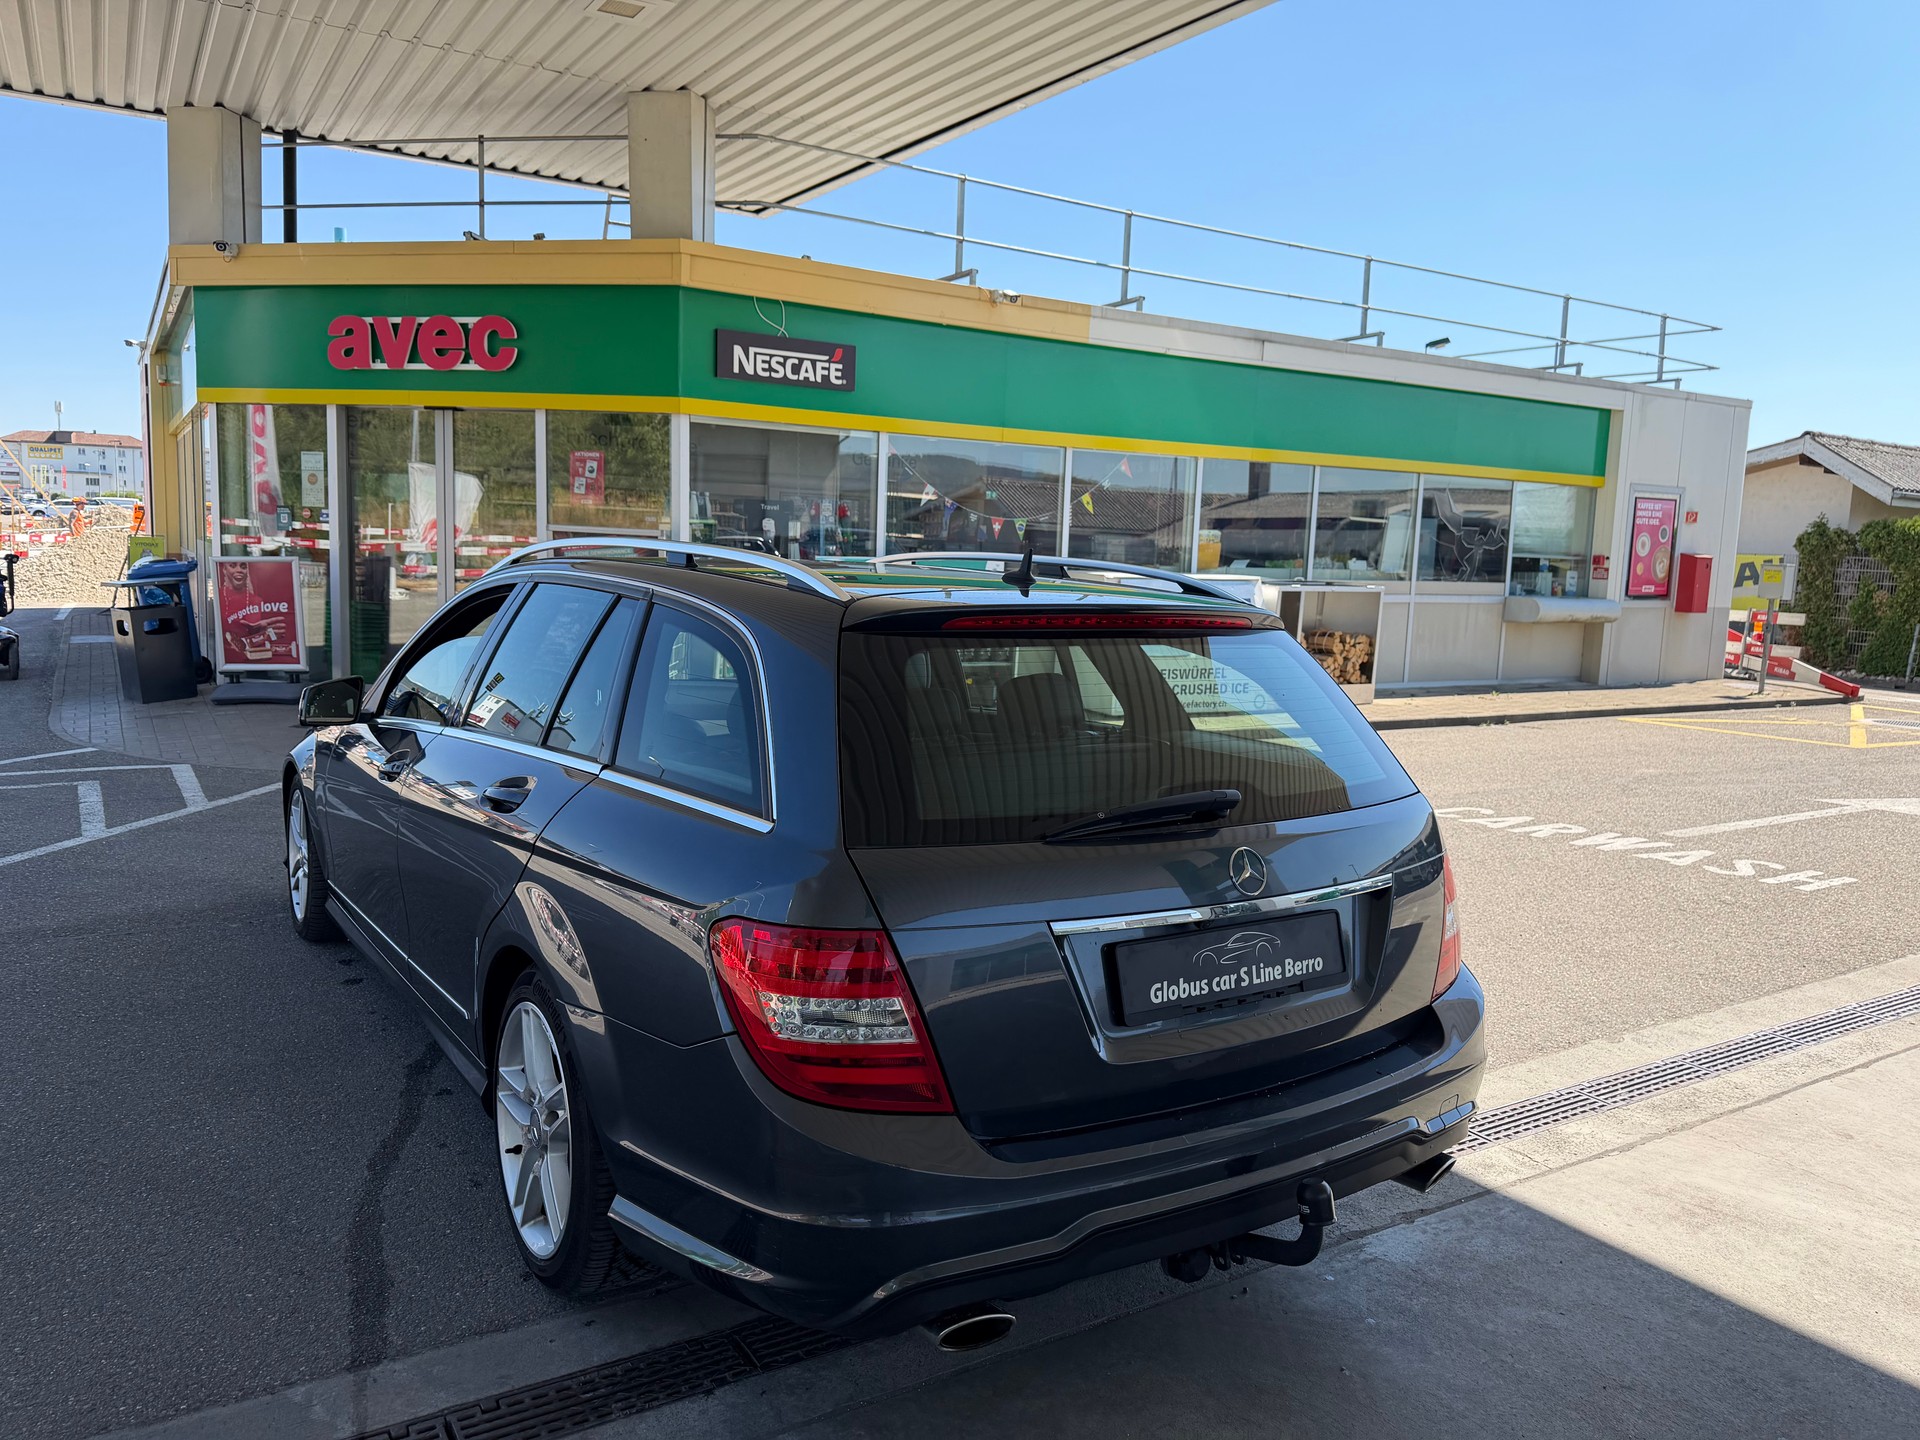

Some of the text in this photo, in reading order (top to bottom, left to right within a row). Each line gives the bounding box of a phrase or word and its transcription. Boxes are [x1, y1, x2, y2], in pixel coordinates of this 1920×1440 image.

[327, 315, 519, 371] avec
[732, 343, 845, 387] NESCAFÉ
[761, 503, 780, 511] Travel
[227, 601, 289, 624] you gotta love
[1161, 666, 1227, 680] EISWÜRFEL
[1774, 666, 1790, 676] KIBAG
[1174, 683, 1249, 695] CRUSHED ICE
[1150, 956, 1323, 1003] Globus car S Line Berro
[533, 979, 565, 1035] Continental
